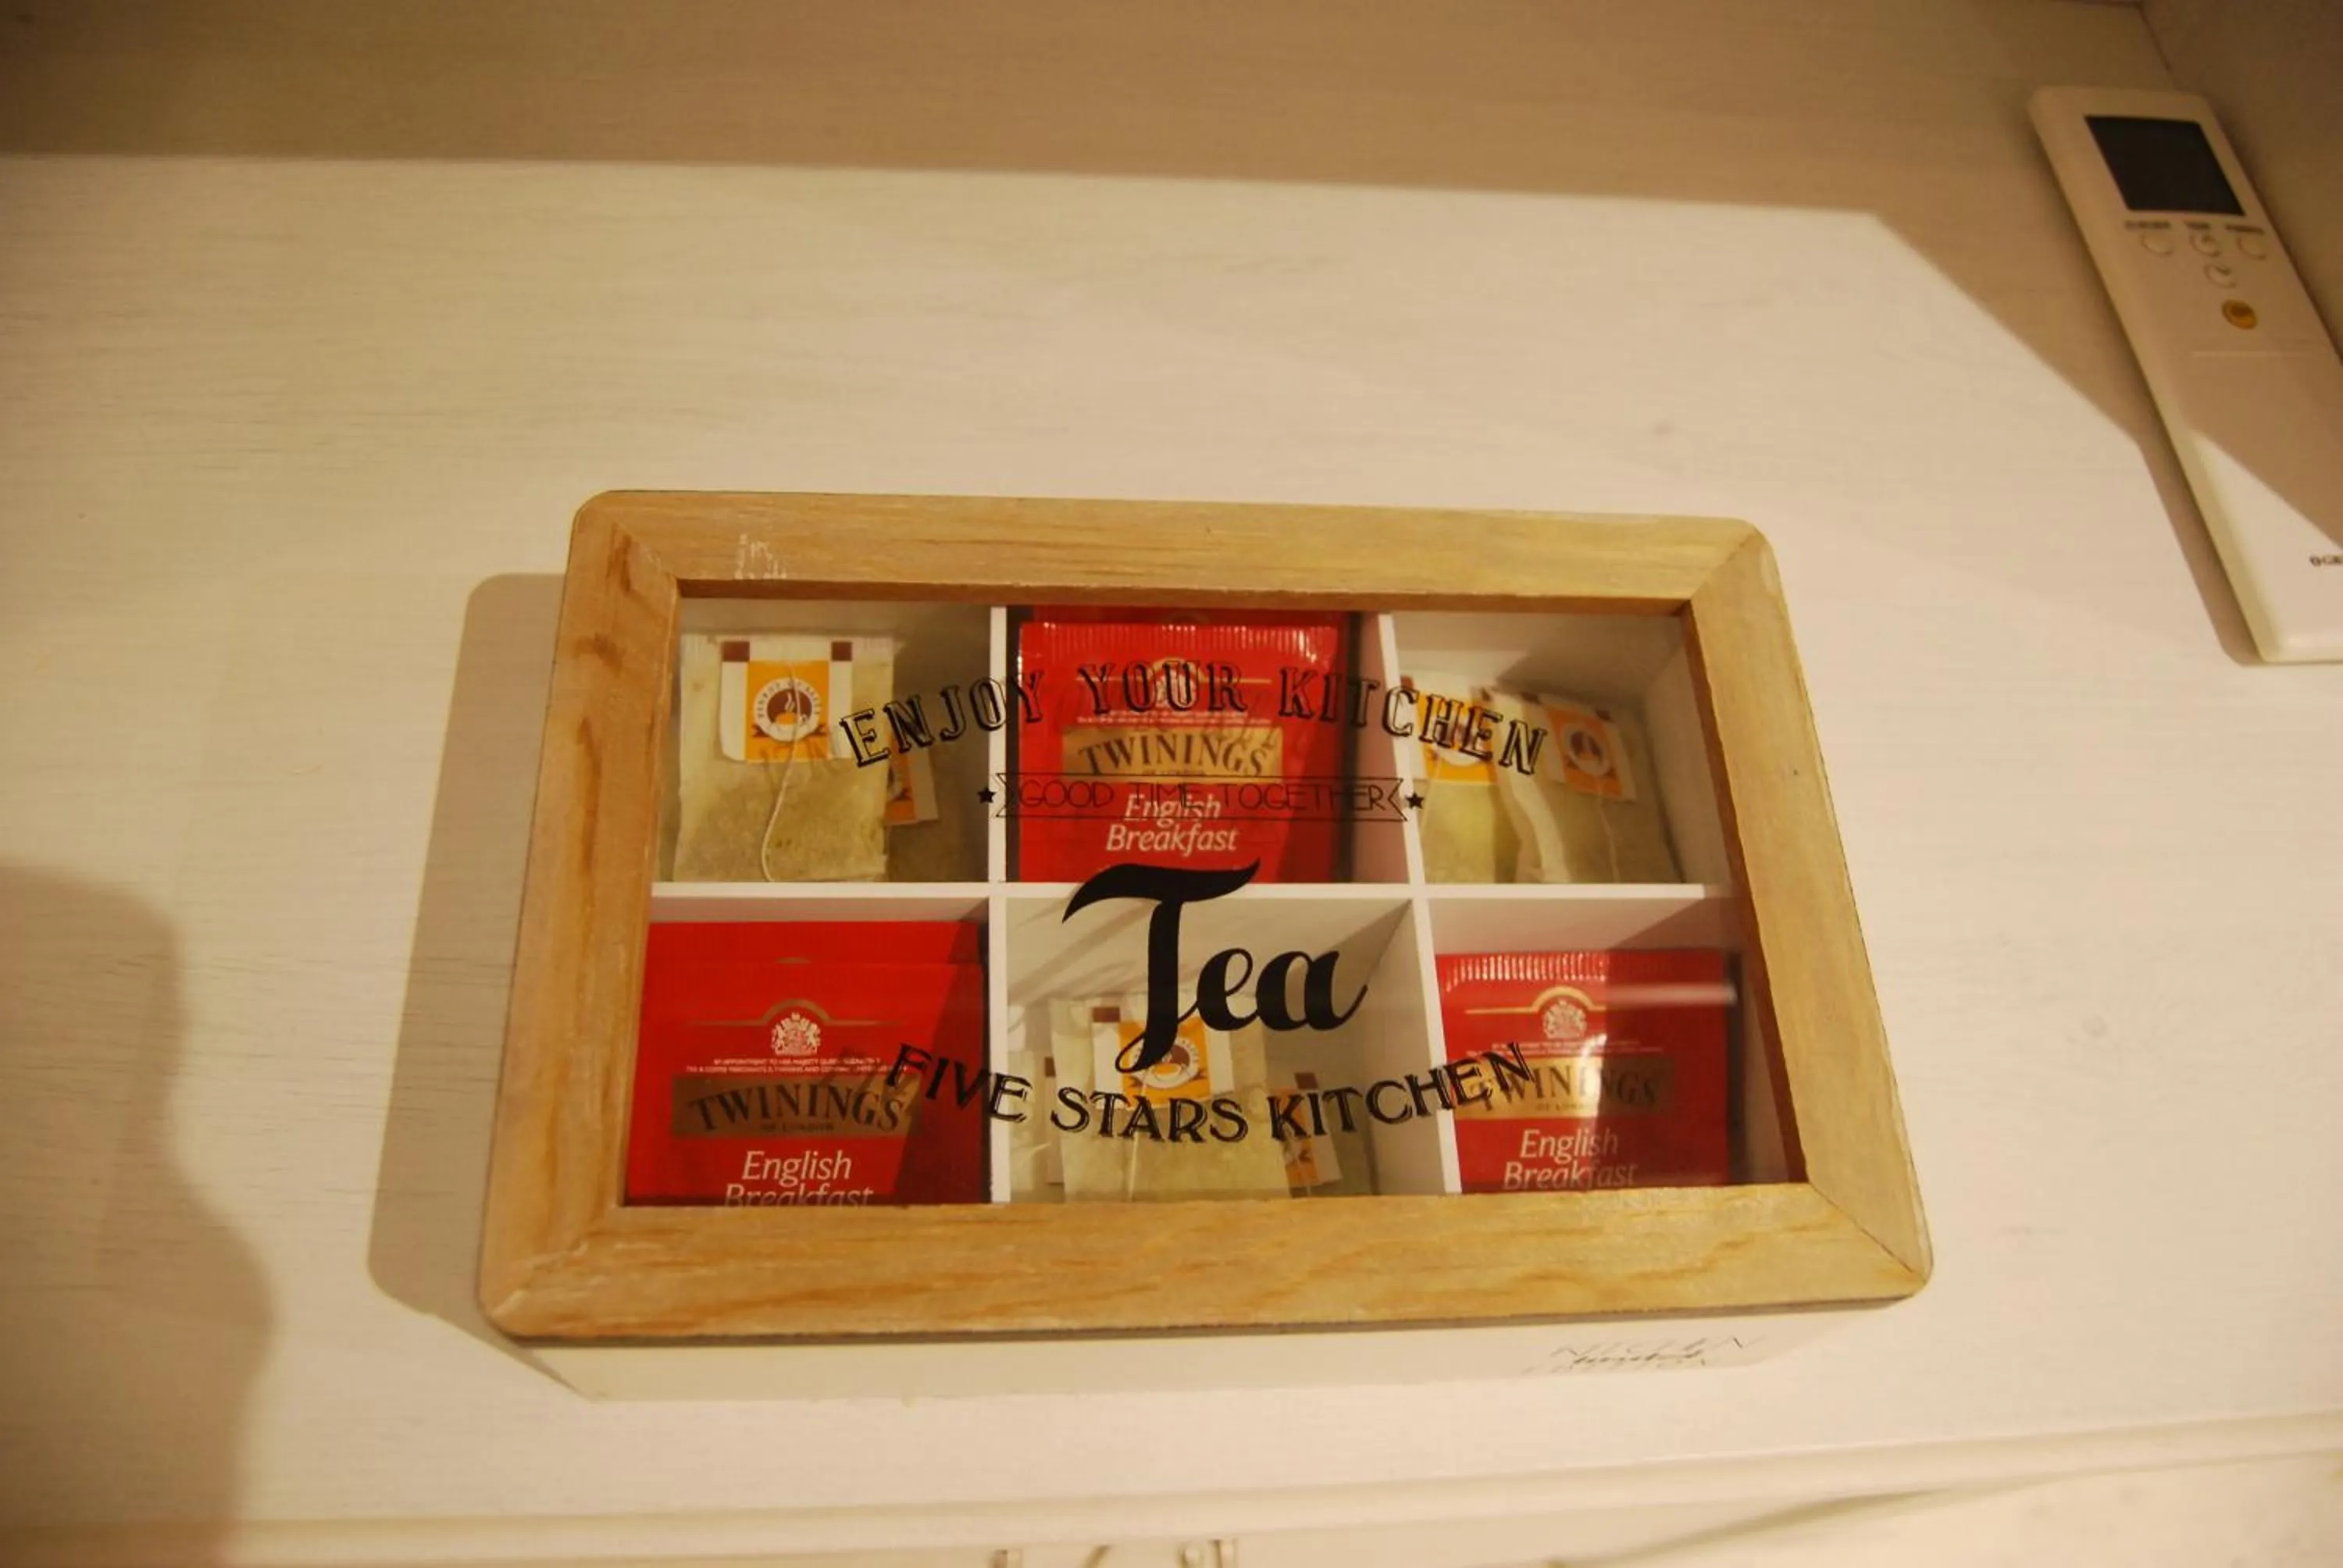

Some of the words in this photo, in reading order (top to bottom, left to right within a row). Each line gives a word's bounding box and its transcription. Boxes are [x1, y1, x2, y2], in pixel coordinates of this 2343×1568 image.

[839, 670, 1046, 768] ENJOY
[1077, 660, 1249, 715] YOUR
[1278, 664, 1548, 775] KITCHEN
[1078, 732, 1268, 778] TWININGS
[1019, 780, 1114, 807] GOOD
[1128, 782, 1203, 809] TIME
[1216, 782, 1385, 811] TOGETHER
[1124, 793, 1221, 828] English
[1106, 824, 1239, 857] Breakfast
[1062, 858, 1368, 1073] Tea
[688, 1083, 905, 1133] TWININGS
[886, 1043, 1032, 1123] FIVE
[1050, 1086, 1249, 1143] STARS
[1268, 1042, 1535, 1141] KITCHEN
[1519, 1127, 1619, 1164] English
[742, 1149, 852, 1188] English
[1503, 1160, 1639, 1192] Breakfast
